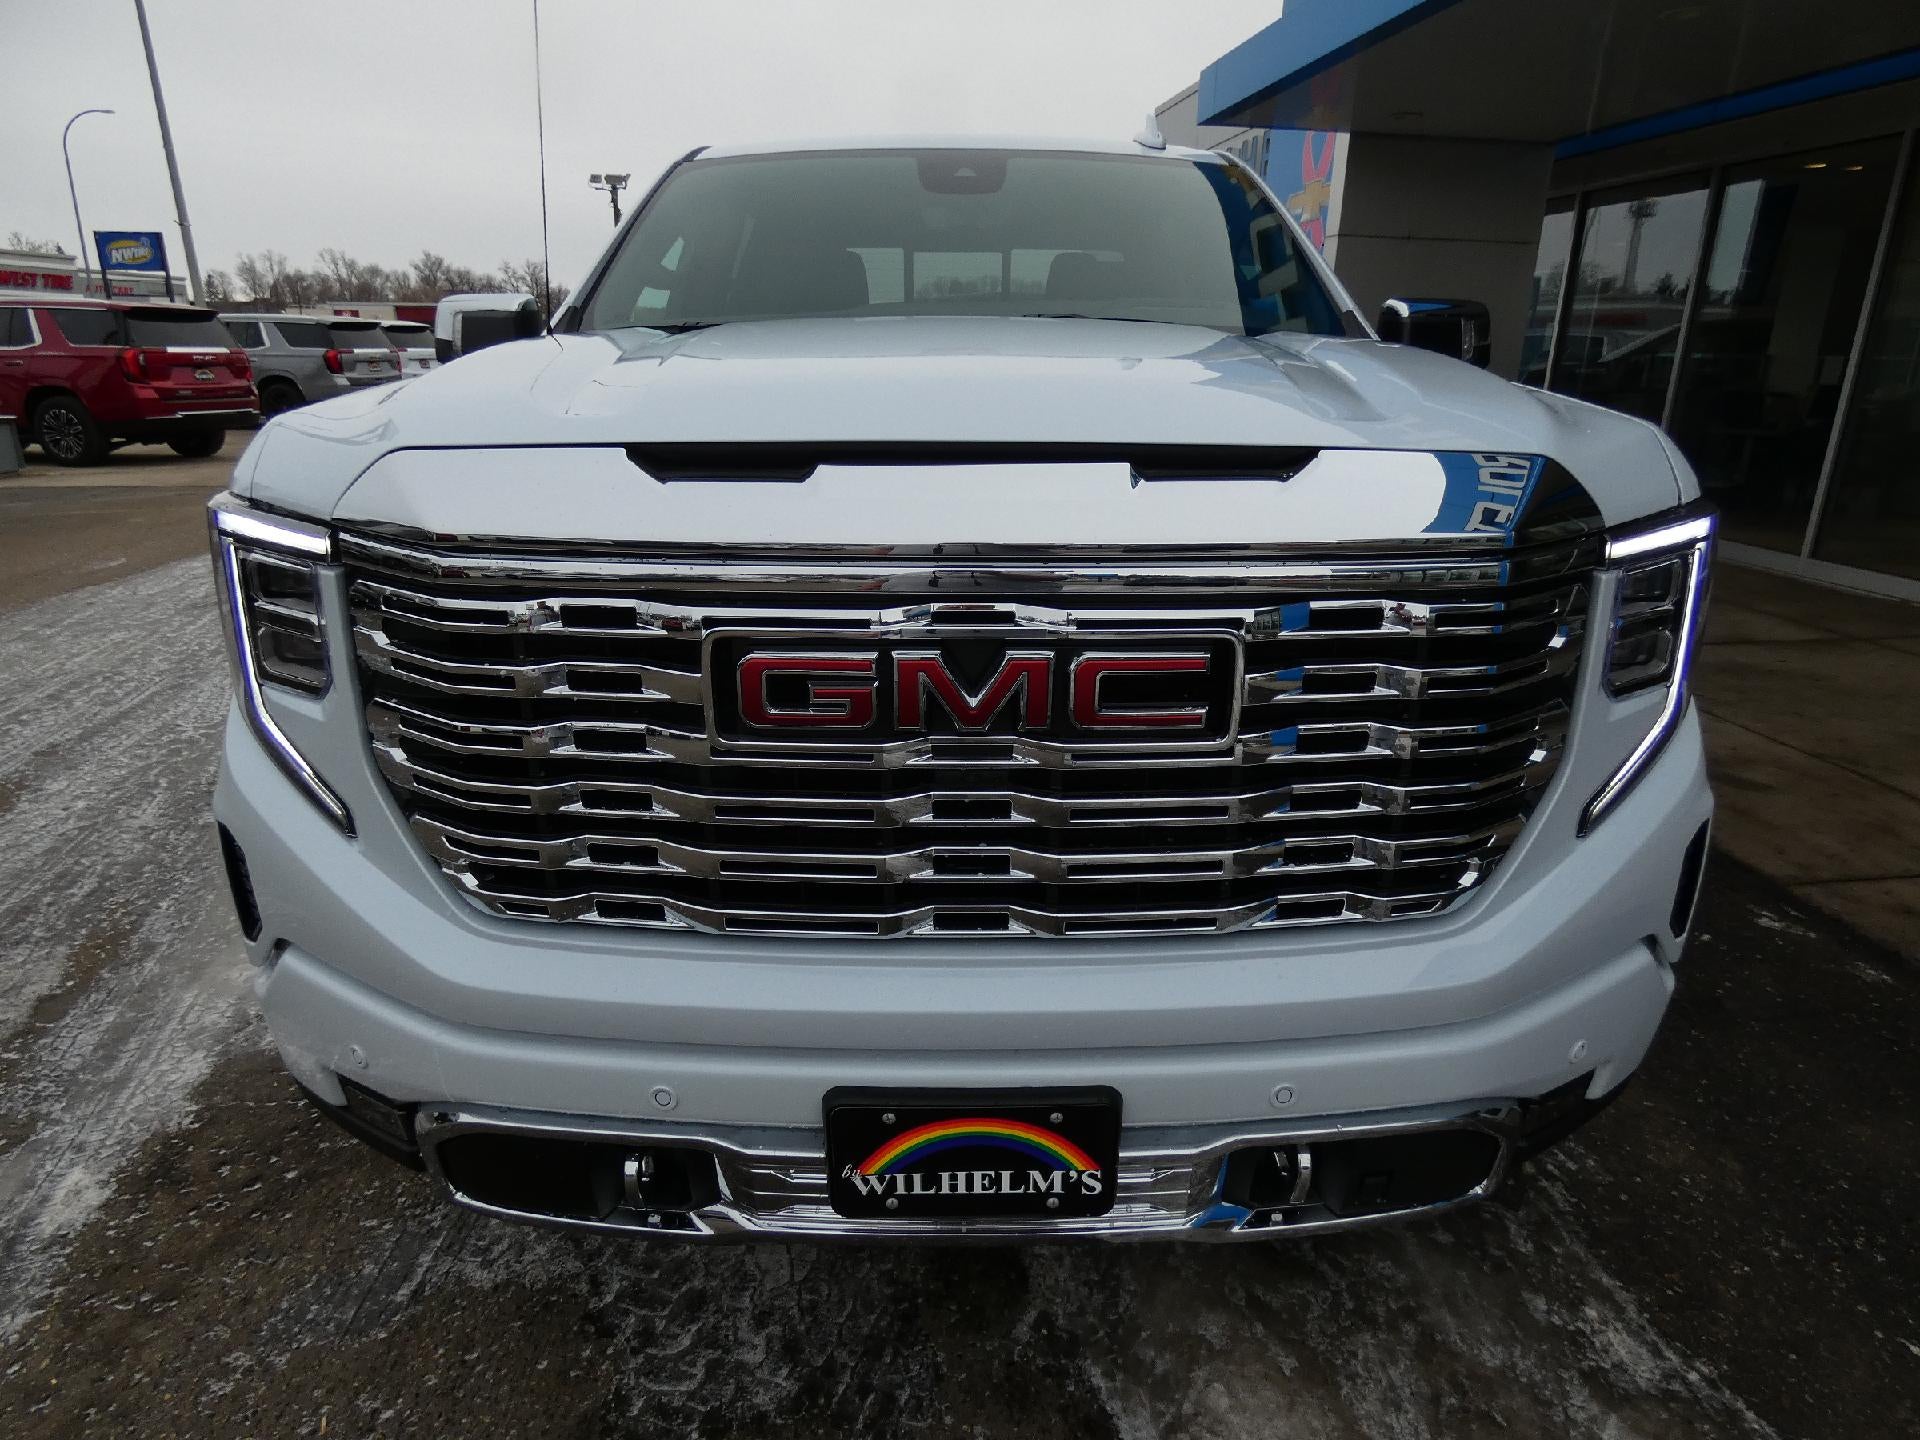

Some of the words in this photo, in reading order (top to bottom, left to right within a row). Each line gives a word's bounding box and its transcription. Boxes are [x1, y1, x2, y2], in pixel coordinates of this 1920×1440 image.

[736, 650, 1211, 732] GMC
[842, 1163, 864, 1181] by
[852, 1169, 1104, 1196] WILHELM'S
